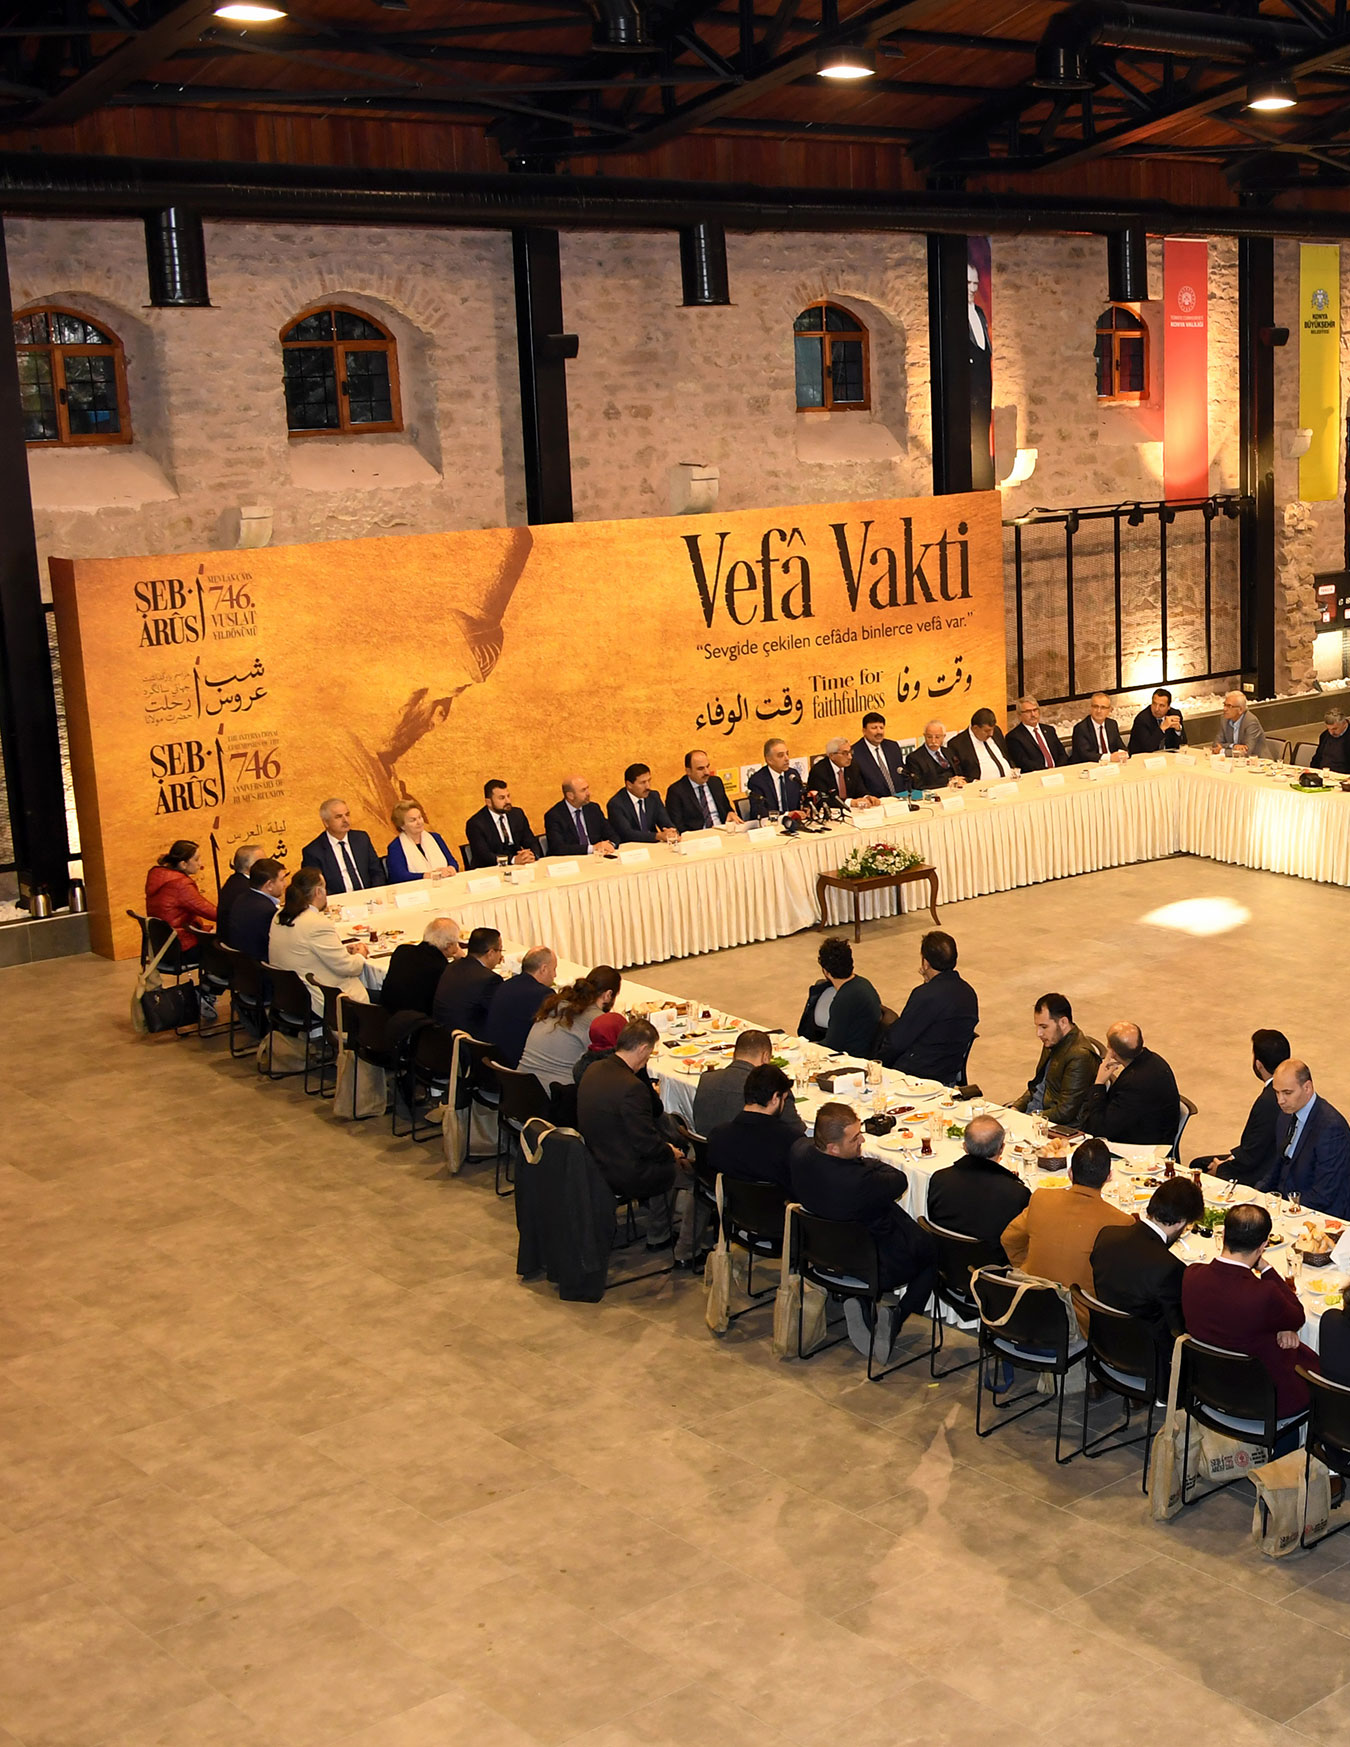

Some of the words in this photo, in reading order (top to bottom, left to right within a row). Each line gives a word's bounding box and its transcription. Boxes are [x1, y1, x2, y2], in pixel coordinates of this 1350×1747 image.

[680, 527, 816, 628] Vefâ
[828, 517, 974, 613] Vakti
[208, 582, 256, 611] 746.
[139, 611, 200, 648] ARÛS
[211, 610, 257, 628] VUSLAT
[762, 635, 811, 658] çekilen
[815, 627, 858, 647] cefâda
[861, 622, 913, 641] binlerce
[916, 617, 943, 633] vefâ
[204, 658, 265, 692] شب
[808, 674, 854, 693] Time
[859, 668, 884, 686] for
[896, 665, 921, 703] وفا
[927, 655, 973, 698] وقت
[205, 686, 268, 716] عروس
[695, 692, 749, 736] الوفاء
[755, 687, 804, 725] وقت
[812, 690, 886, 719] faithfulness
[229, 746, 282, 782] 746
[154, 775, 219, 816] ARÛS
